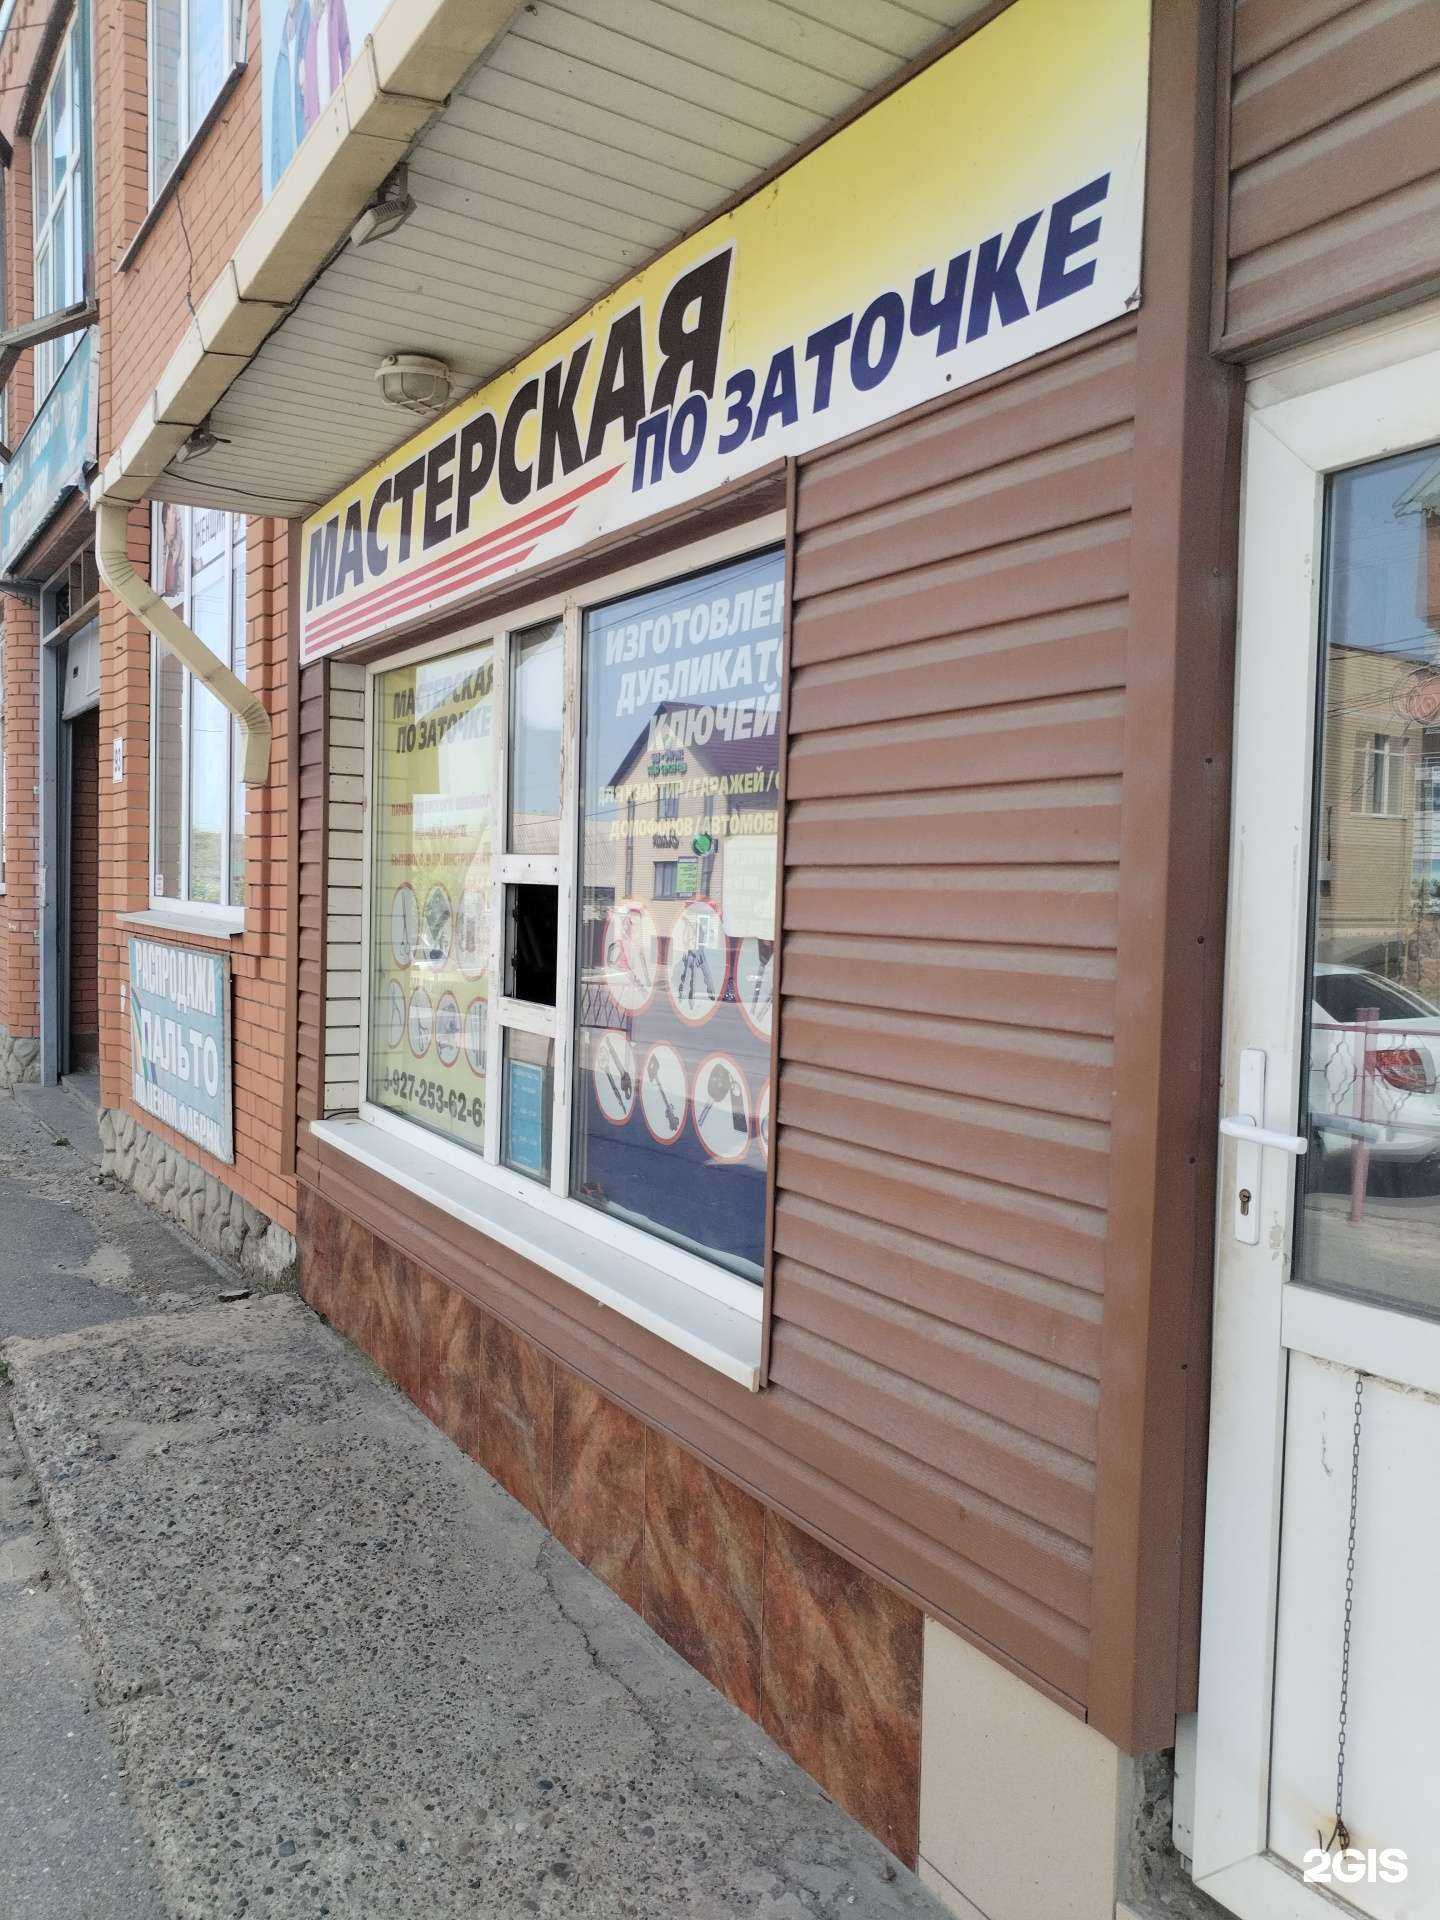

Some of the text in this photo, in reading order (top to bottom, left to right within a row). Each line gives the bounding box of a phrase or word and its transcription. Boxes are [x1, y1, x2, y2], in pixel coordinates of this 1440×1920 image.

[632, 172, 1110, 493] ПО ЗАТОЧКЕ
[306, 250, 733, 613] МАСТЕРСКАЯ
[396, 724, 416, 754] ПО
[649, 682, 780, 751] КЛЮЧЕЙ
[135, 942, 216, 1016] РАСПРОДАЖА
[140, 1007, 219, 1097] ПАЛЬТО
[383, 1065, 486, 1127] 8-927-253-62-6
